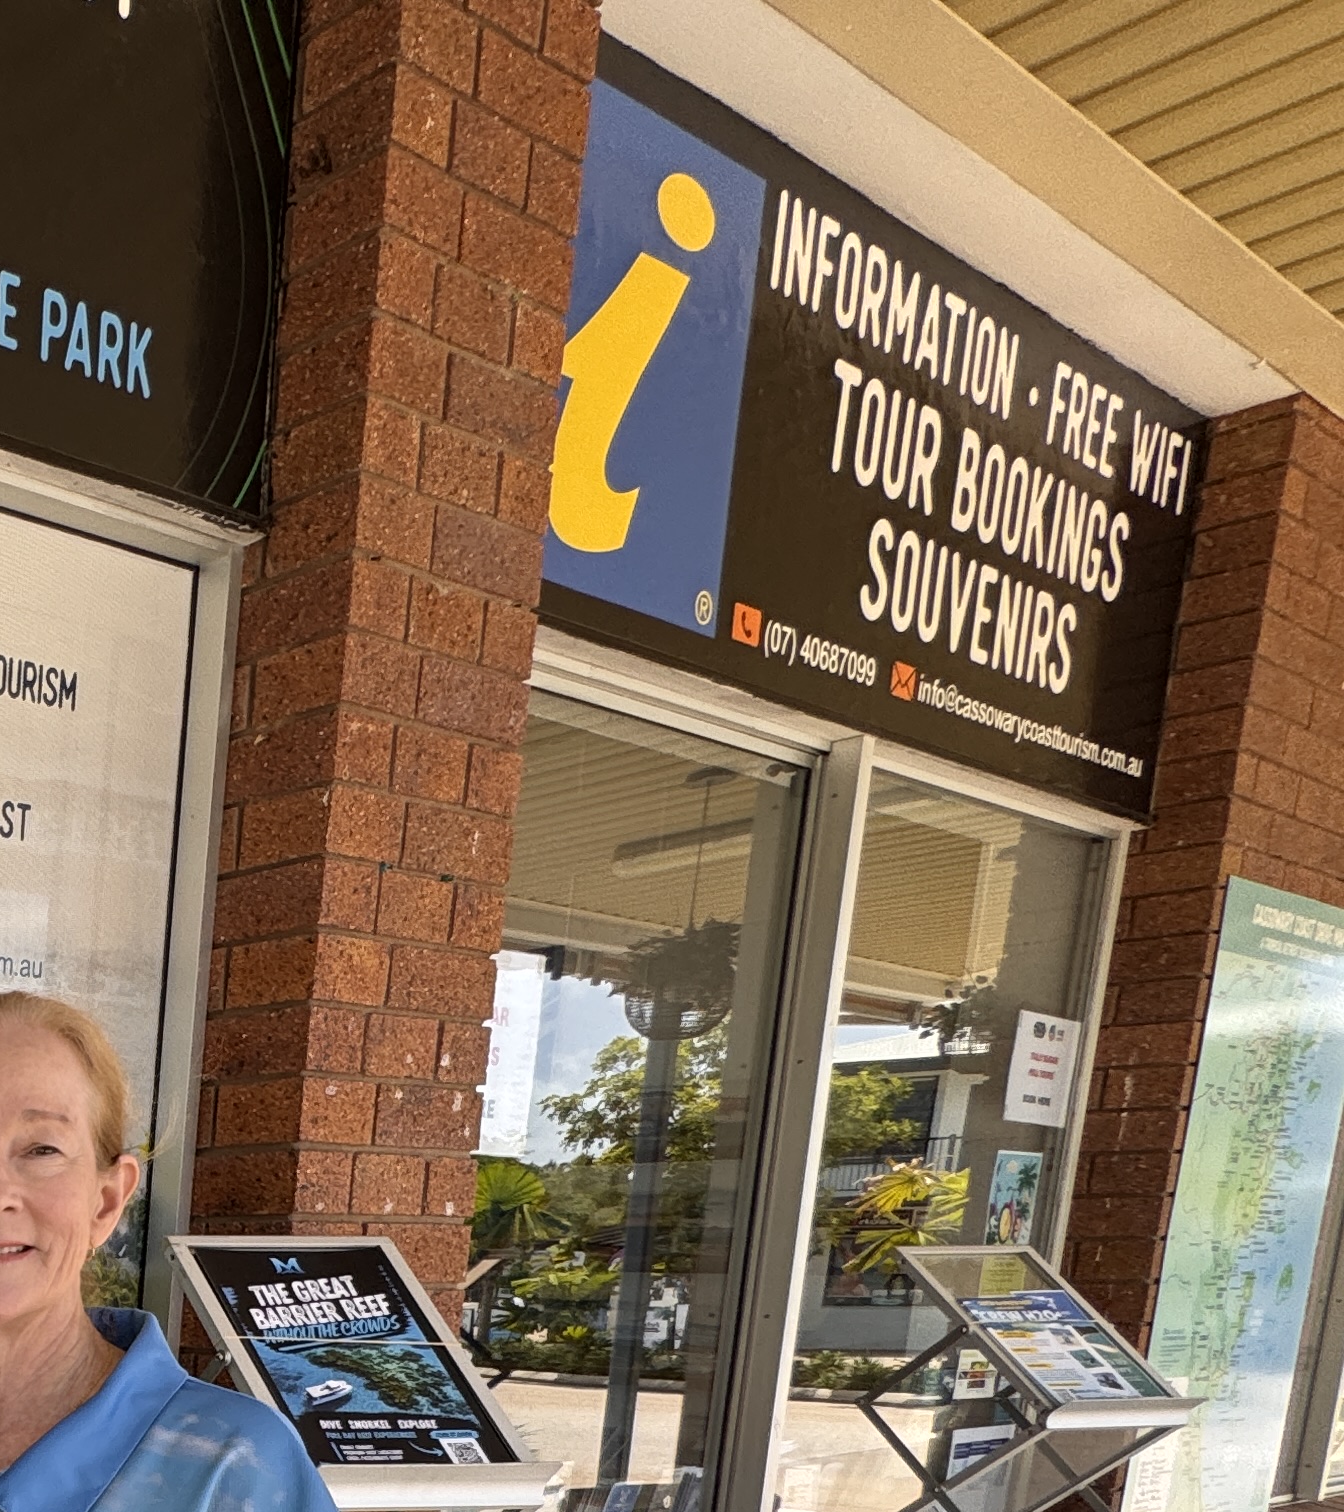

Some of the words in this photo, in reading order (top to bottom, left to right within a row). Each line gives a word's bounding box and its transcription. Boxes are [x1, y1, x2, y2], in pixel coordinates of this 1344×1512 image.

[42, 288, 153, 399] PARK
[770, 188, 1020, 421] INFORMATION
[1046, 361, 1125, 479] FREE
[1132, 409, 1192, 516] WIFI
[830, 359, 945, 517] TOUR
[951, 444, 1131, 603] BOOKINGS
[860, 518, 1078, 696] SOUVENIRS
[763, 621, 796, 667] (07)
[800, 633, 877, 688] 40687099
[917, 673, 1144, 778] info@cassowarycoasttourism.com.au
[247, 1282, 295, 1307] THE
[291, 1274, 358, 1304] GREAT
[248, 1301, 344, 1331] BARRIER
[339, 1293, 391, 1321] REEF
[340, 1314, 401, 1336] CROWDS
[319, 1419, 343, 1430] DIVE
